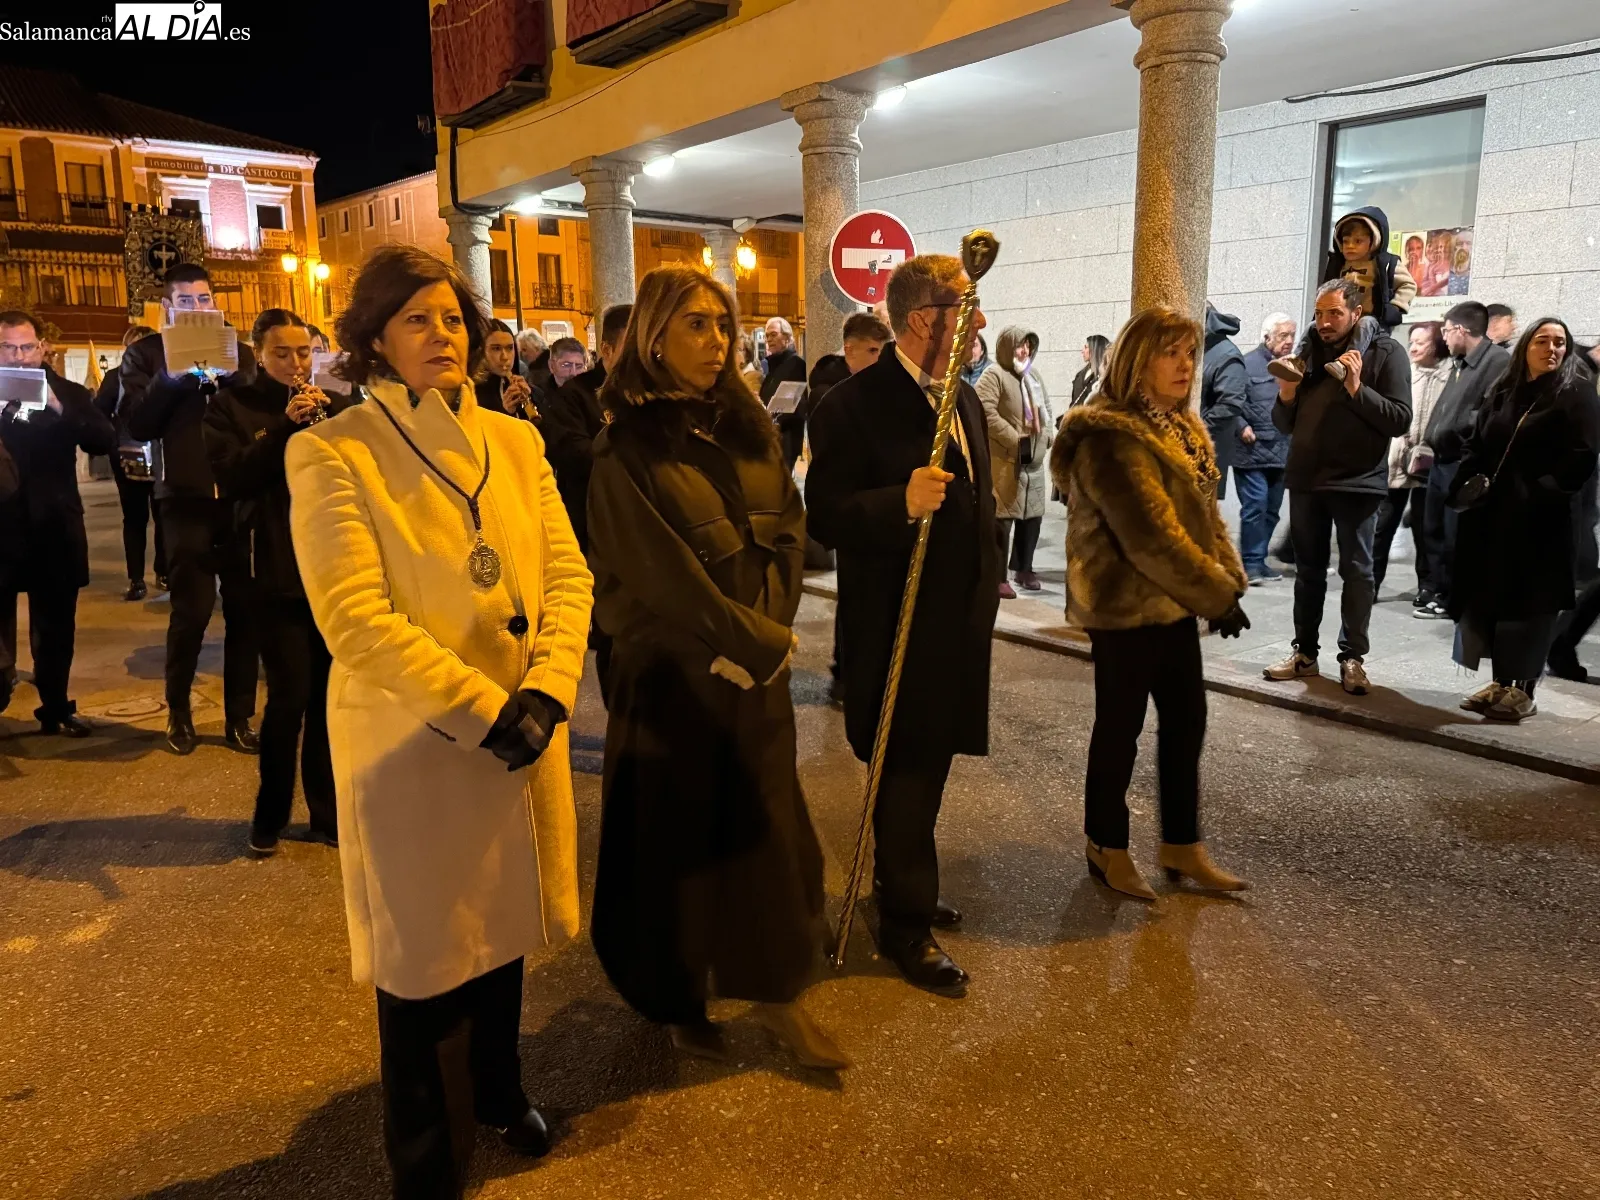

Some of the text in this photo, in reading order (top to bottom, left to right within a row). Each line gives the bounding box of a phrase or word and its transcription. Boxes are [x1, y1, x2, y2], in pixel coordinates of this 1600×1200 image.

[220, 164, 235, 174] DE
[236, 166, 278, 179] CASTRO
[280, 169, 298, 180] GIL
